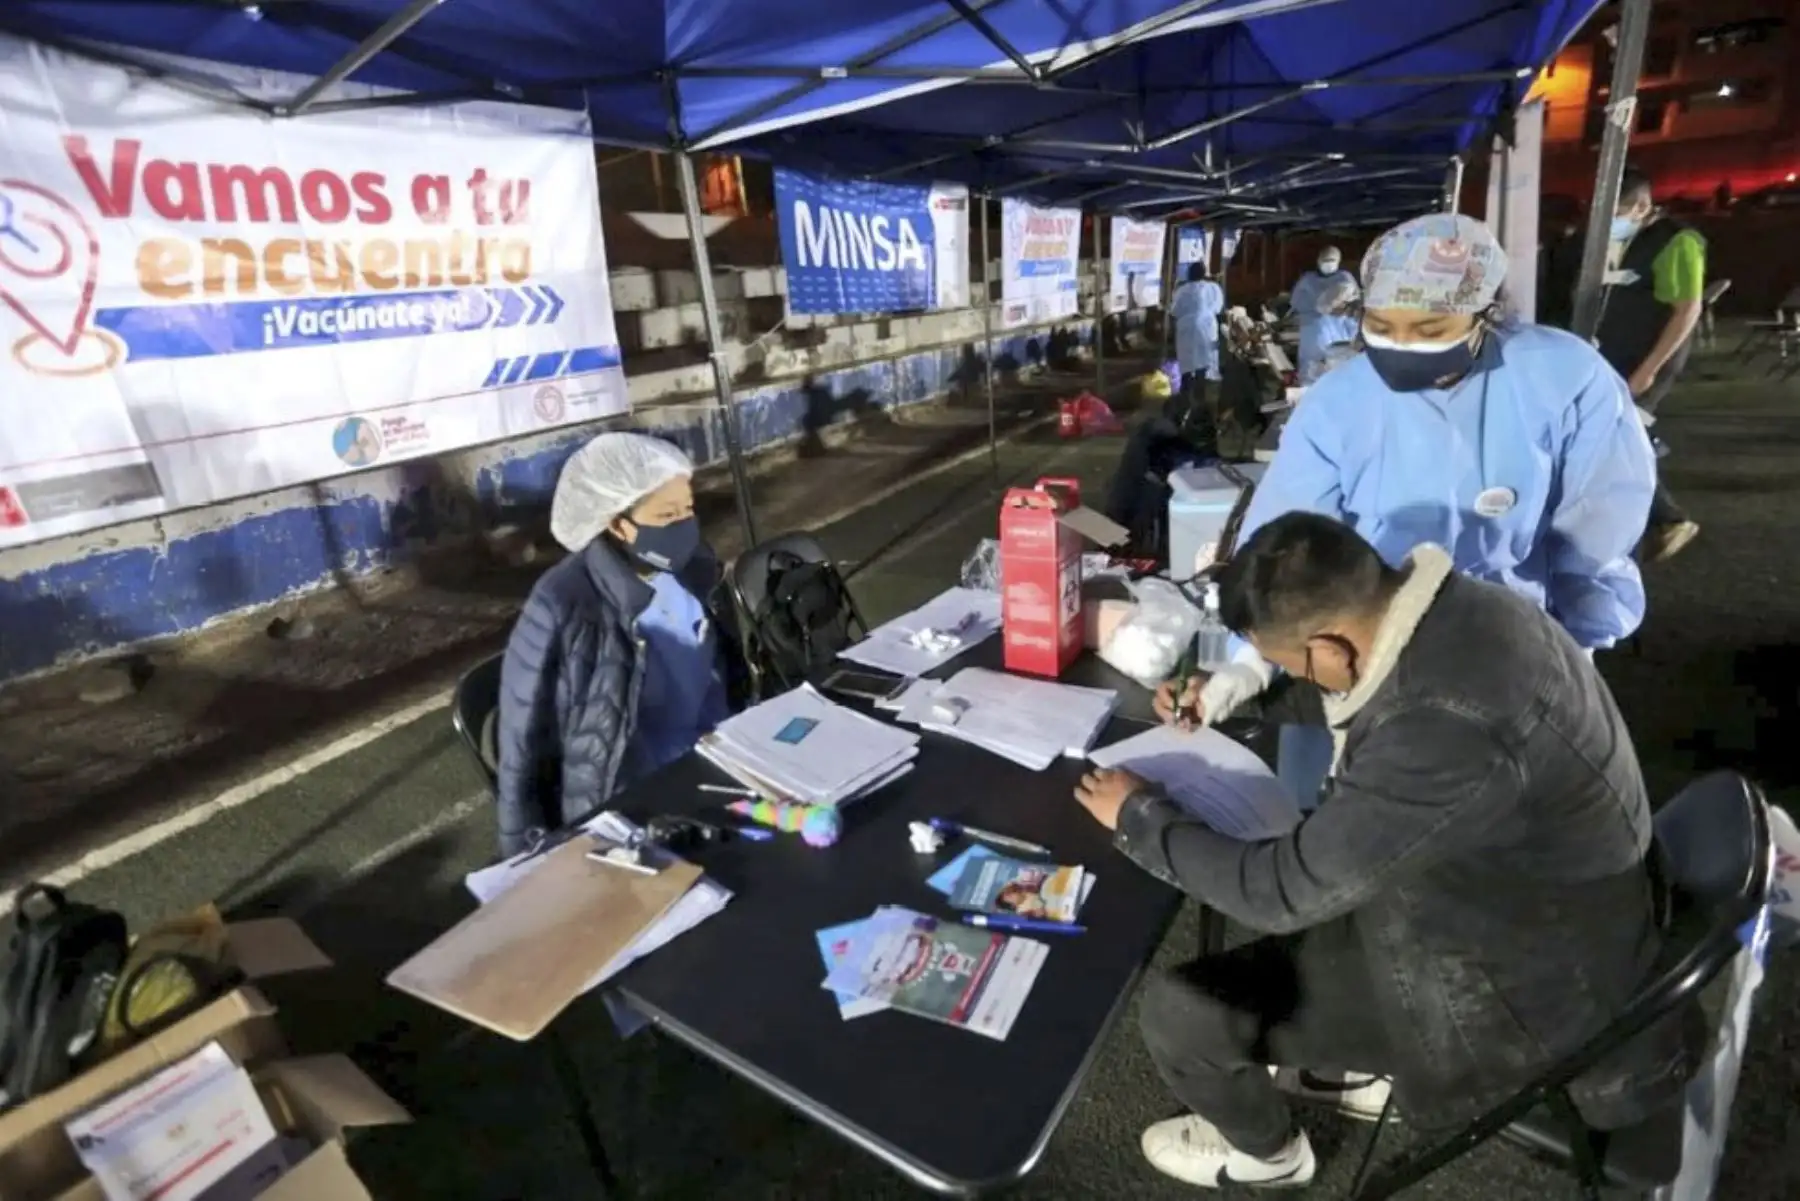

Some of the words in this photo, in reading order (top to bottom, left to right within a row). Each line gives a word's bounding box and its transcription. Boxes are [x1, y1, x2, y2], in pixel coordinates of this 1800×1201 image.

[65, 135, 392, 224] Vamos
[411, 173, 451, 224] a
[467, 168, 531, 225] tu
[135, 230, 532, 299] encuentro
[794, 200, 926, 270] MINSA
[263, 298, 424, 344] ¡Vacúnate
[433, 295, 470, 328] ya!
